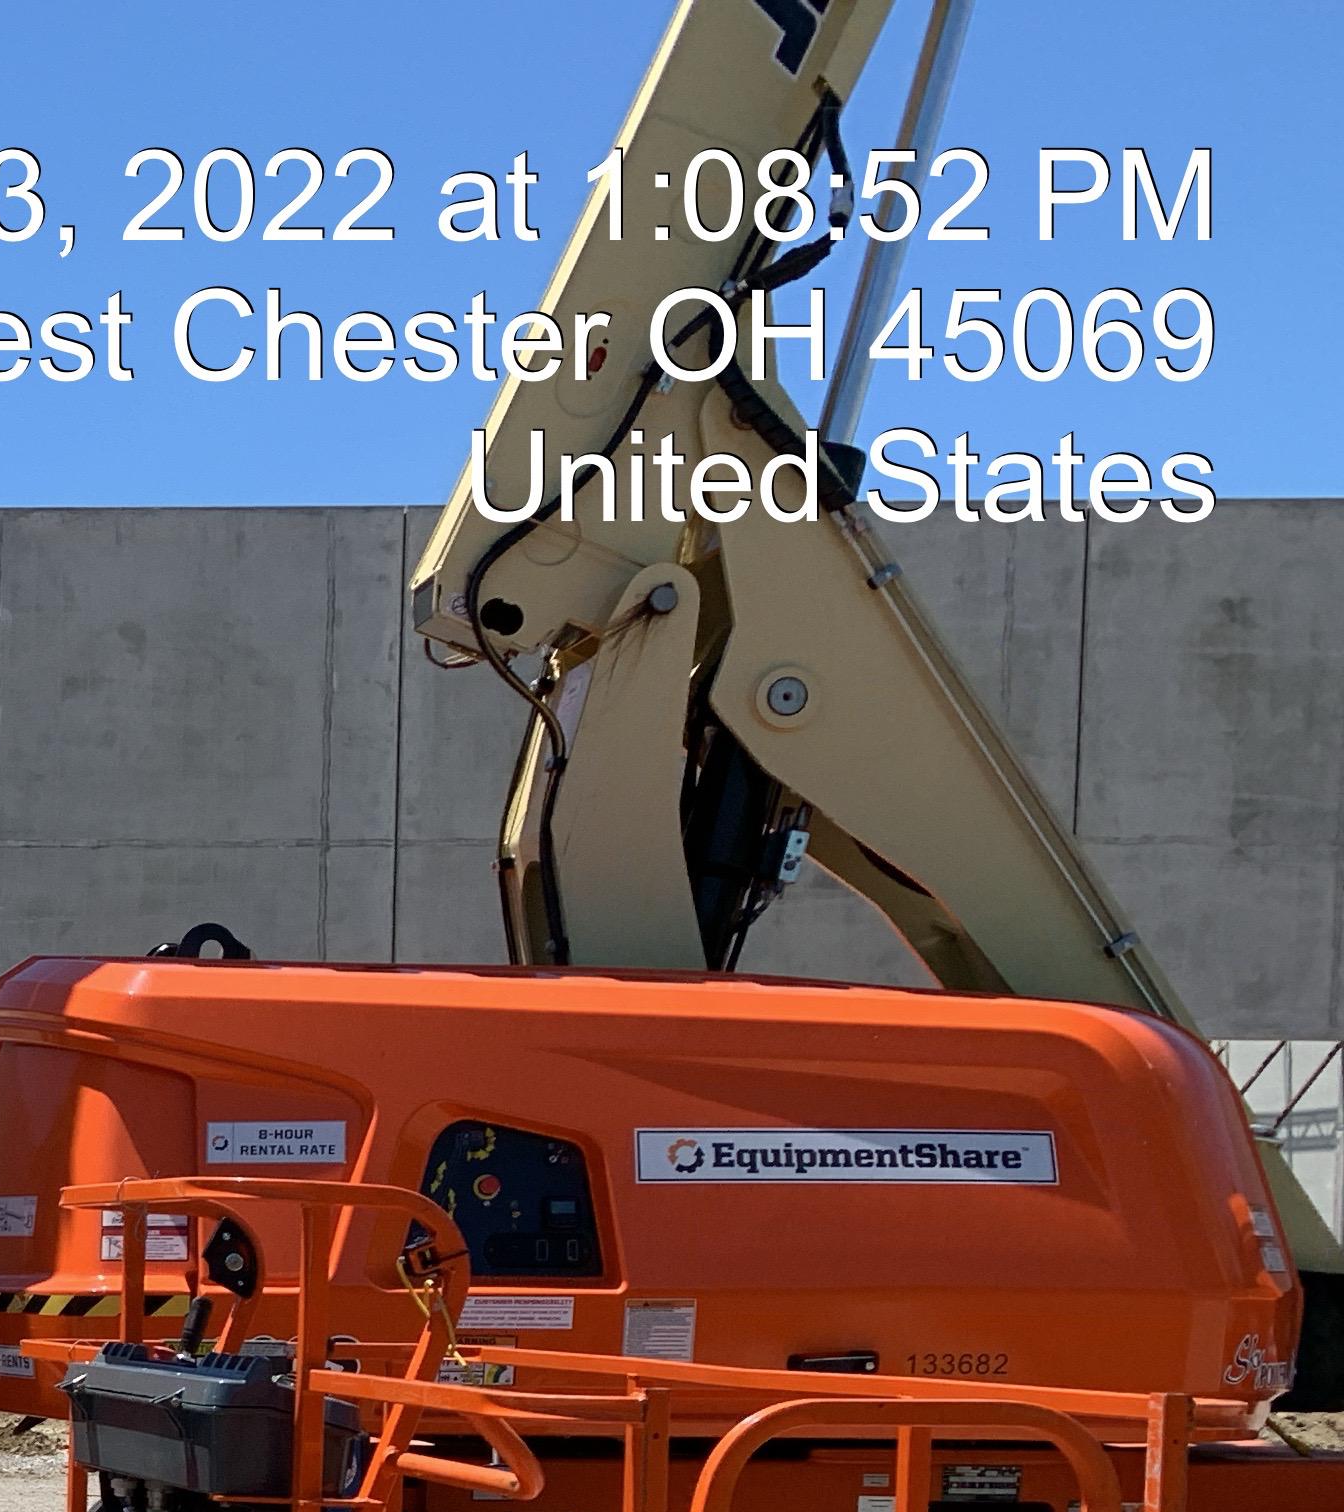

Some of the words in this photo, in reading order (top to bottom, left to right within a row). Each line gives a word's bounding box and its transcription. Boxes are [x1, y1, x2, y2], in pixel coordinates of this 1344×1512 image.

[258, 1129, 314, 1140] 8-HOUR
[239, 1145, 295, 1156] RENTAL
[299, 1144, 336, 1155] RATE
[712, 1142, 1023, 1174] EquipmentShare
[906, 1353, 1009, 1375] 133682
